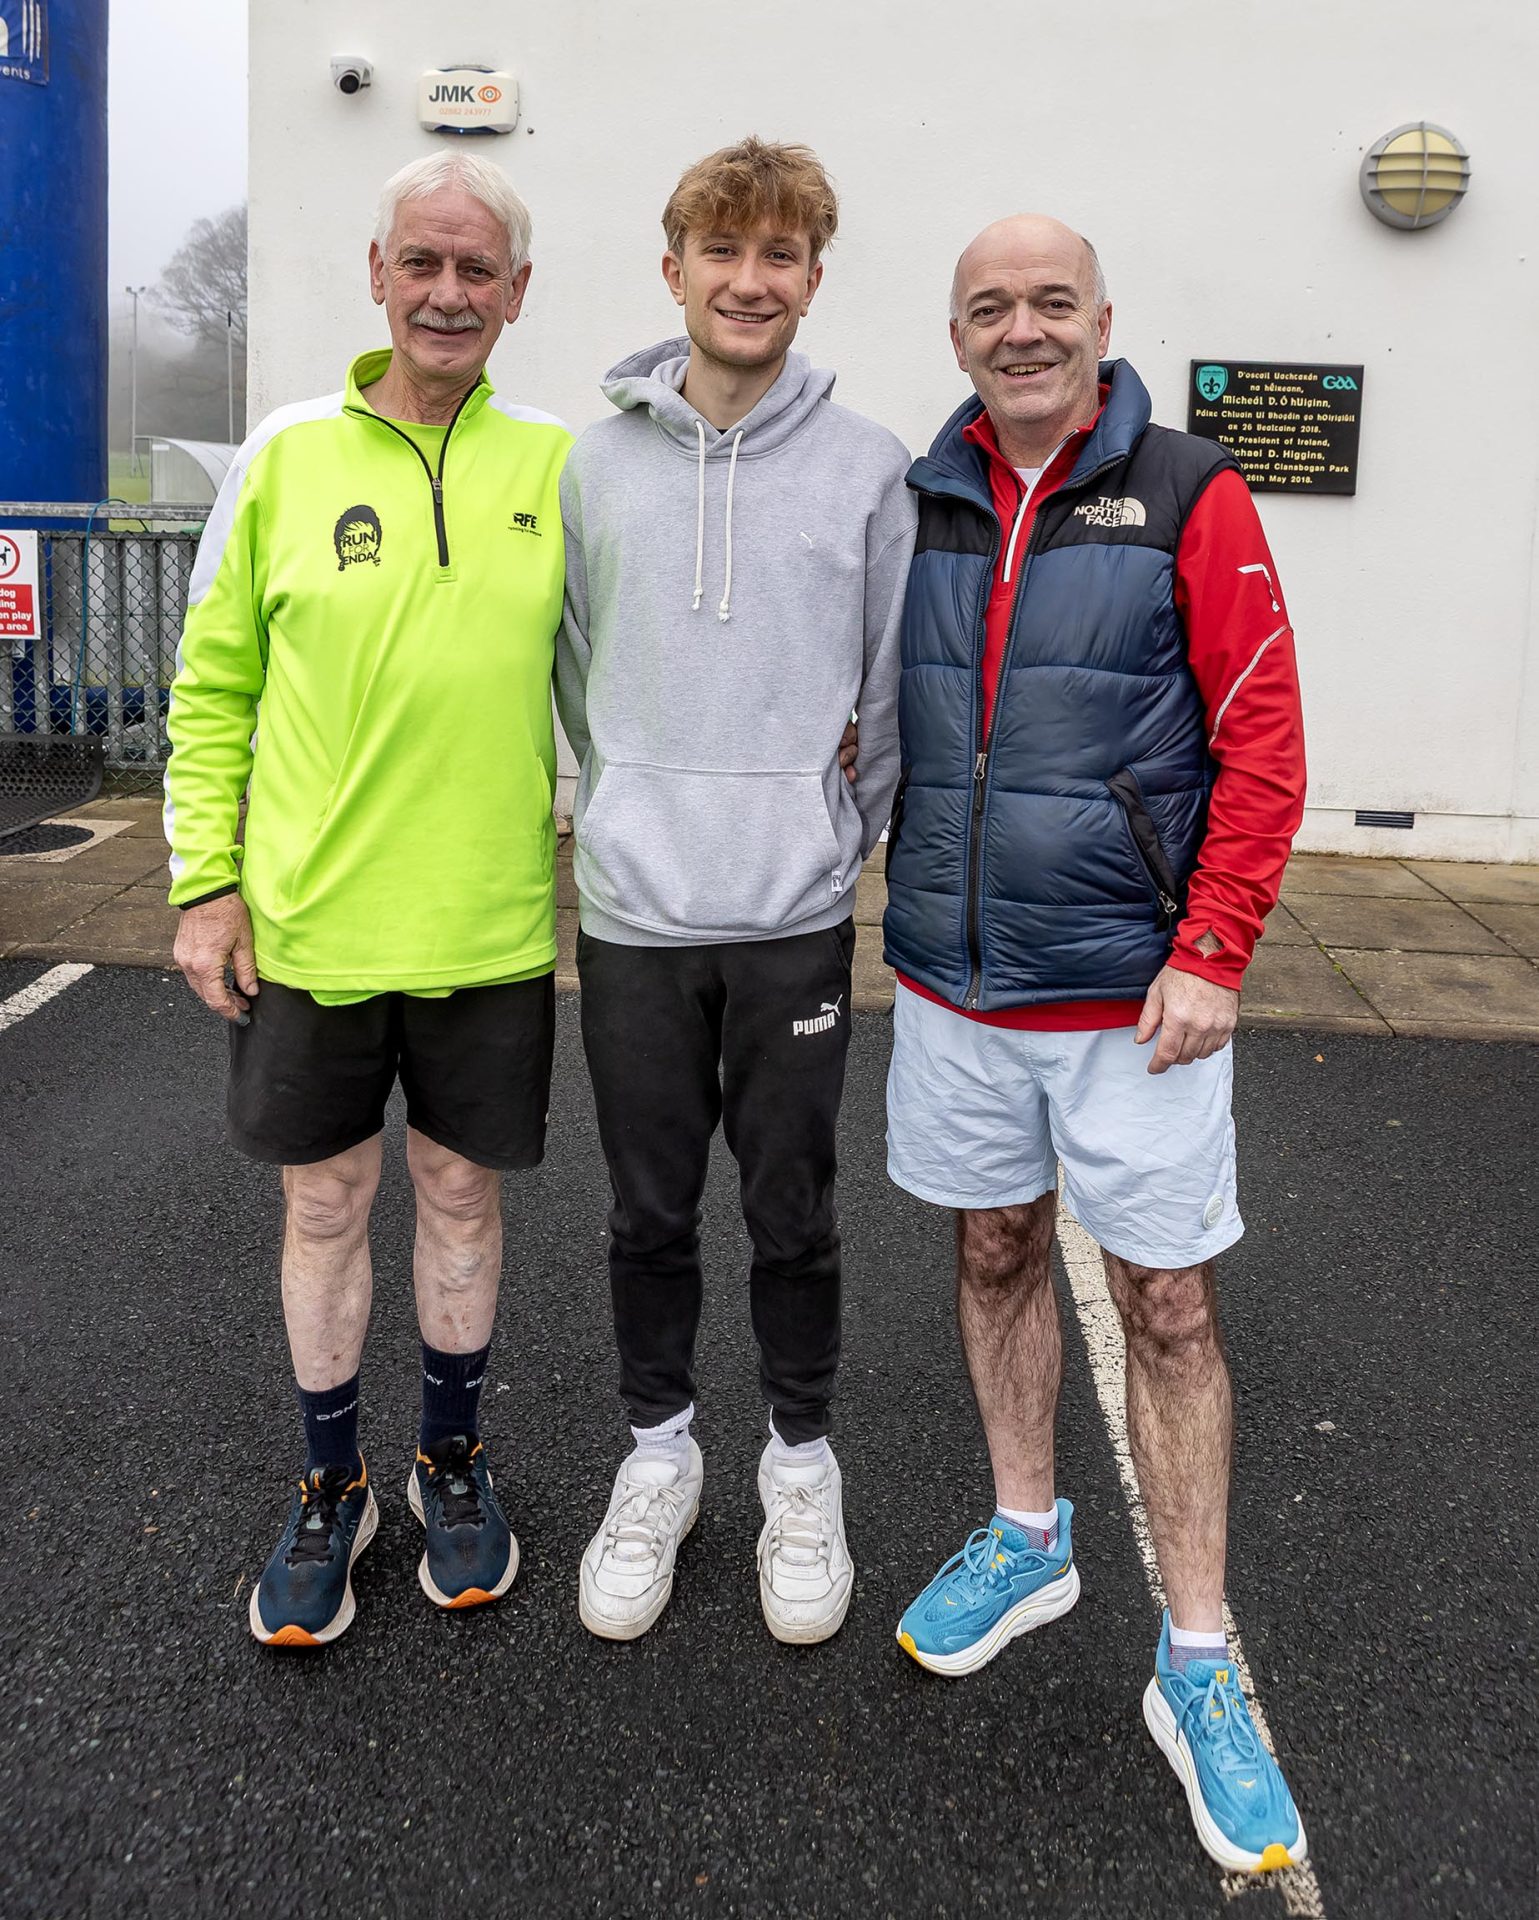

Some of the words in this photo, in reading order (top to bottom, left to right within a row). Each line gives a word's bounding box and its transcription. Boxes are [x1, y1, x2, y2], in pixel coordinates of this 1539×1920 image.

[428, 85, 476, 103] JMK
[1268, 396, 1278, 406] D.
[1280, 395, 1288, 406] Ó
[1222, 410, 1252, 418] Chluain
[1218, 435, 1234, 443] The
[1238, 436, 1280, 444] President
[1284, 437, 1294, 445] of
[1297, 438, 1330, 447] Ireland,
[1268, 450, 1279, 458] D.
[1283, 450, 1325, 460] Higgins,
[1274, 463, 1325, 472] Clanabogan
[1329, 464, 1350, 472] Park
[1268, 475, 1286, 484] May
[1290, 476, 1313, 484] 2018.
[1098, 496, 1124, 508] THE
[1074, 505, 1122, 518] NORTH
[513, 512, 537, 529] RFE
[1086, 515, 1120, 528] FACE
[343, 532, 376, 547] RUN
[348, 544, 370, 555] FOR
[343, 552, 374, 566] ENDA
[12, 610, 32, 621] play
[6, 622, 28, 630] area
[793, 1012, 836, 1036] PUMA
